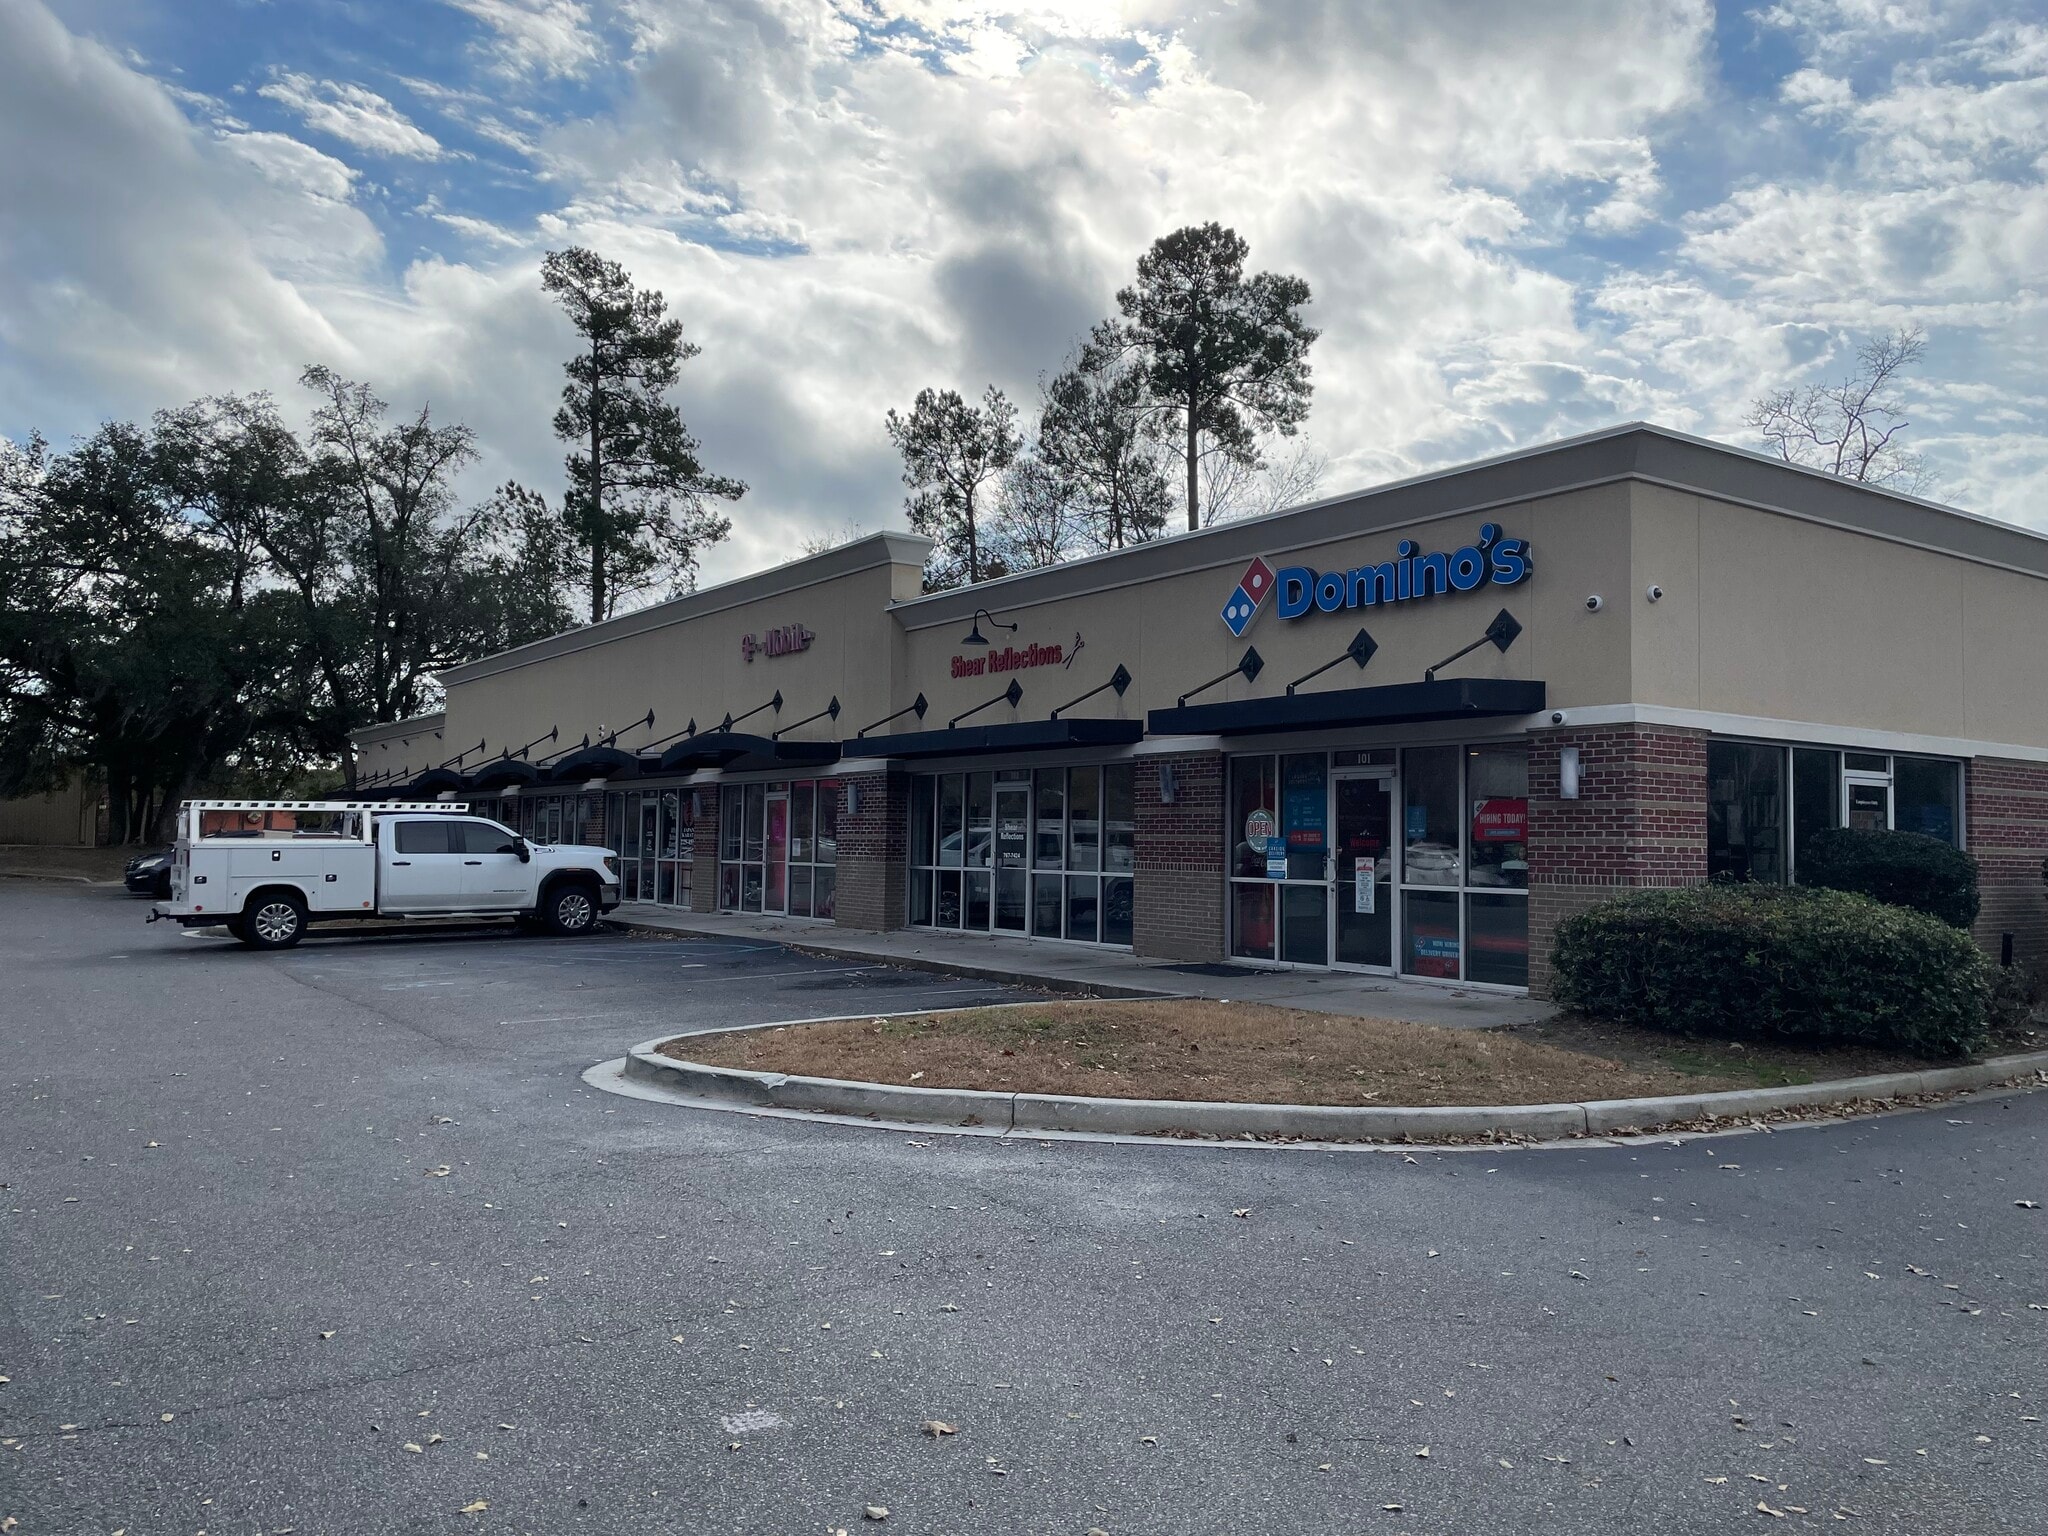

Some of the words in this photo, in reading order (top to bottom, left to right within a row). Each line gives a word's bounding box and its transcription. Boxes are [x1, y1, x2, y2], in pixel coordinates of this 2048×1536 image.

[1276, 523, 1531, 620] Domino's
[951, 655, 985, 679] Shear
[988, 643, 1063, 673] Reflections
[1357, 753, 1371, 764] 101
[1479, 813, 1502, 824] HIRING
[1503, 813, 1526, 824] TODAY!
[1248, 820, 1273, 837] OPEN
